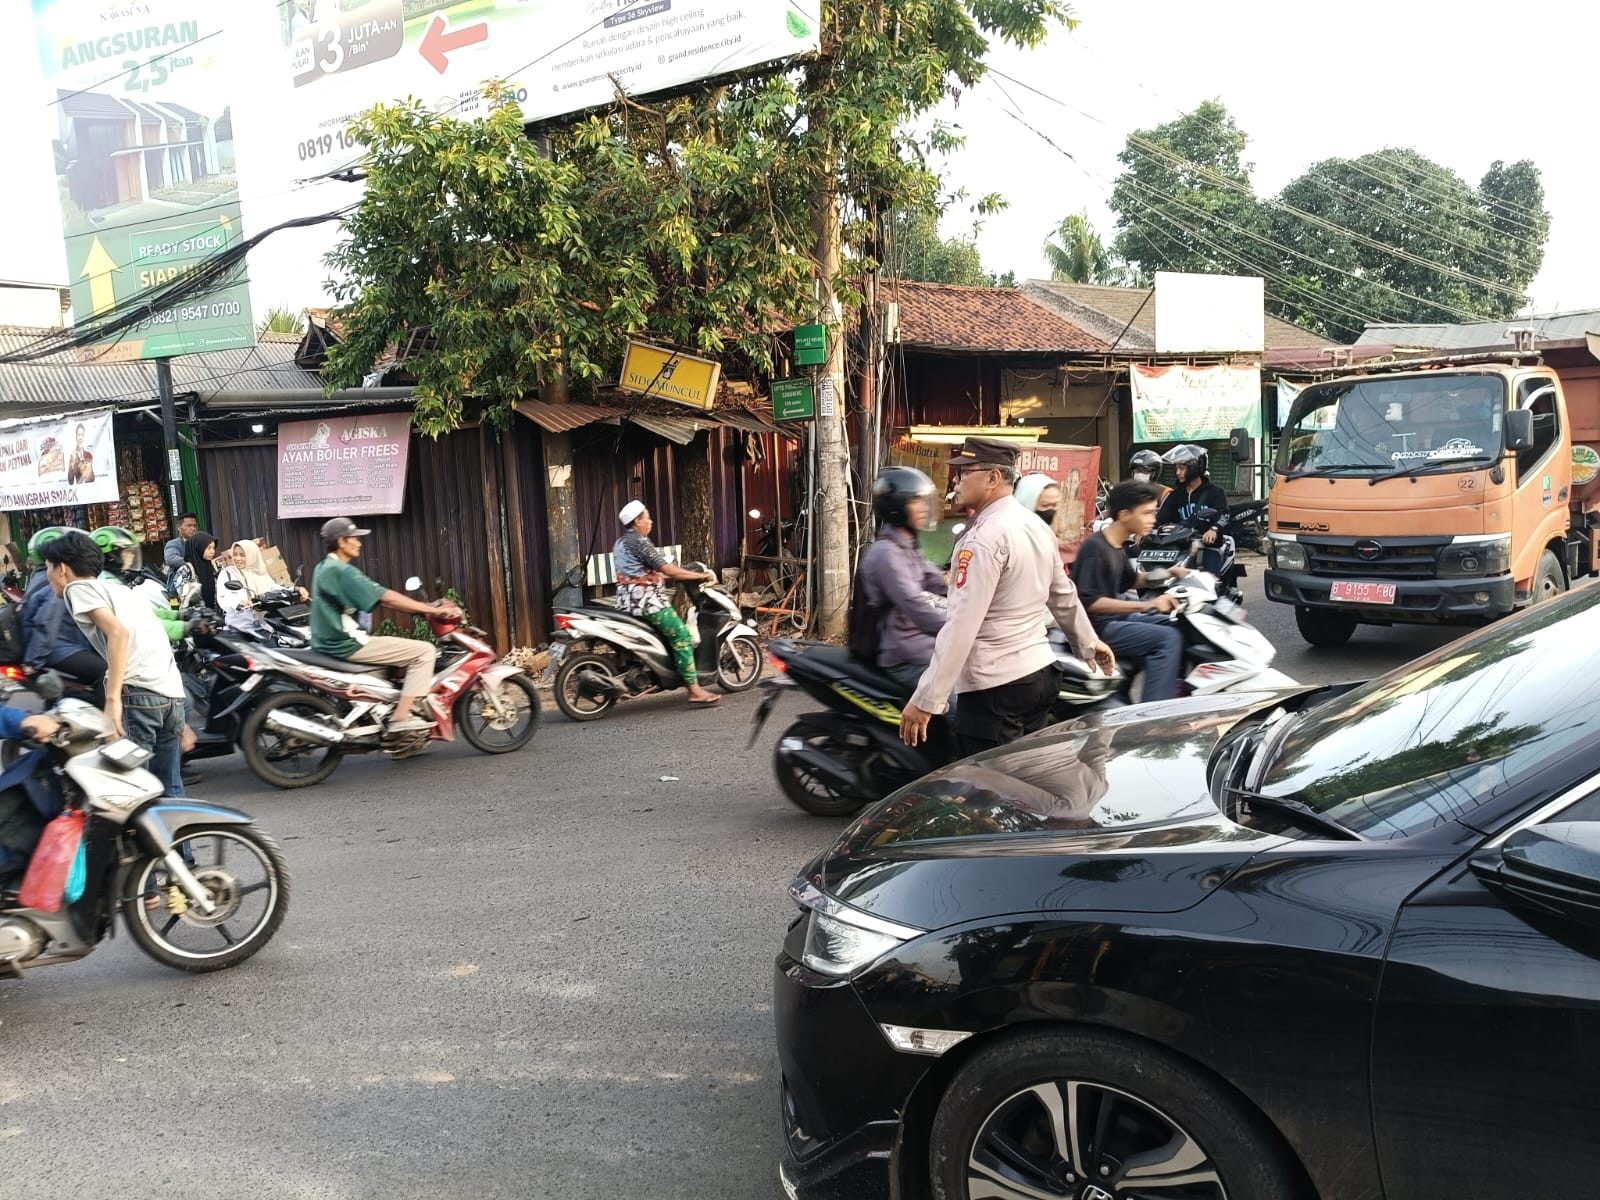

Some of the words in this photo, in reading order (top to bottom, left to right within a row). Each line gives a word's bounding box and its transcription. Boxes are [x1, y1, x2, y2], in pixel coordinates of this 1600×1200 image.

[610, 15, 627, 25] Type
[627, 12, 637, 21] 36
[637, 4, 665, 17] Skyview
[583, 37, 608, 49] Rumah
[608, 28, 636, 42] dengan
[636, 21, 661, 35] desain
[661, 15, 679, 28] high
[680, 8, 705, 21] ceiling
[62, 20, 198, 69] ANGSURAN
[318, 20, 345, 73] 3
[551, 54, 594, 72] memberikan
[595, 45, 625, 60] sirkulasi
[625, 39, 646, 52] udara
[647, 35, 653, 45] &
[655, 23, 705, 45] pencahayaan
[705, 15, 726, 30] yang
[122, 53, 169, 93] 2,5
[298, 133, 333, 161] 0819
[138, 242, 179, 259] READY
[183, 235, 223, 252] STOCK
[182, 306, 209, 321] 9547
[212, 301, 241, 317] 0700
[340, 426, 388, 441] AGISKA
[281, 450, 314, 463] AYAM
[316, 447, 358, 461] BOILER
[360, 443, 400, 458] FREES
[1460, 479, 1475, 488] 22
[13, 491, 51, 507] ANUGRAH
[50, 488, 79, 503] SNACK
[1332, 583, 1338, 594] B
[1345, 584, 1369, 595] 9155
